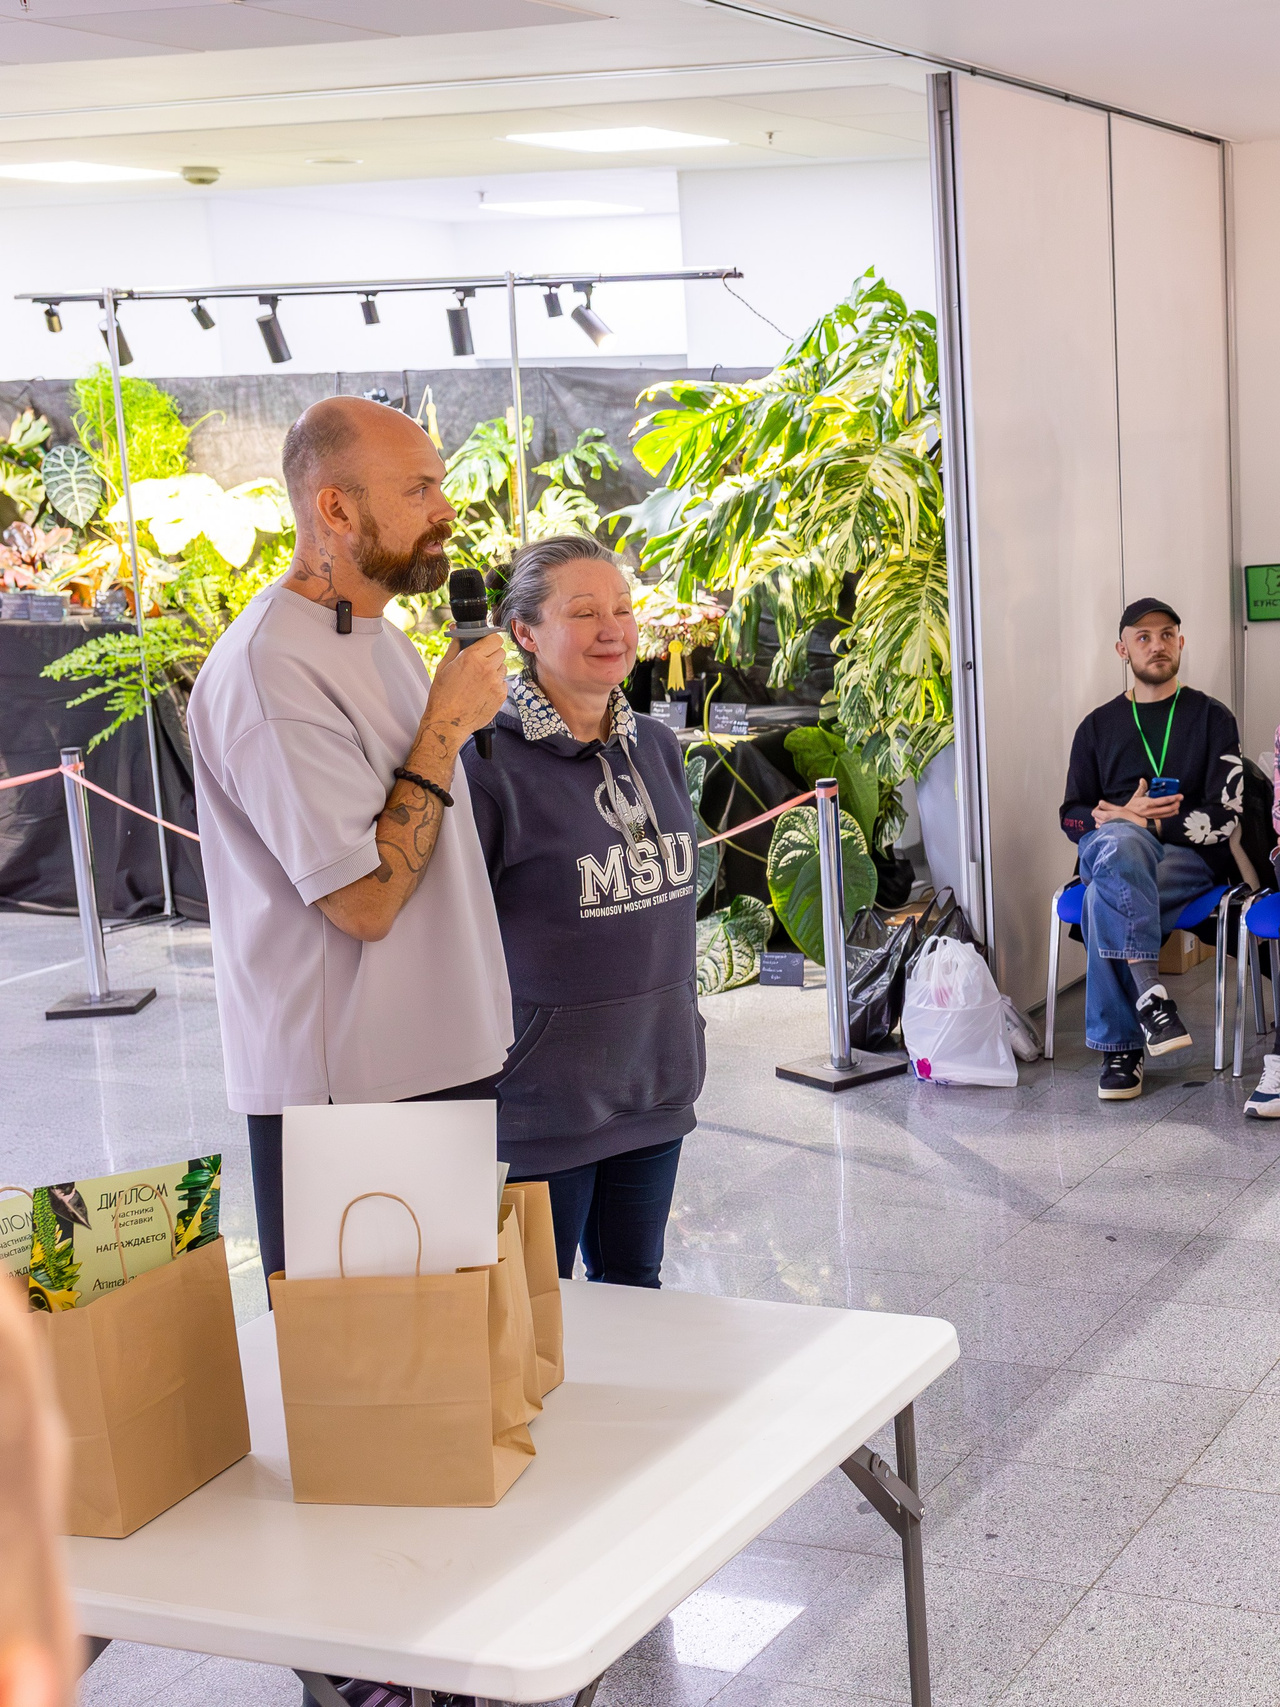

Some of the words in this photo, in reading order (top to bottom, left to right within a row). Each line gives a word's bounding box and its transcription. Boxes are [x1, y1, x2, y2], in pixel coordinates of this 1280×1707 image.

[576, 831, 694, 907] MSU
[580, 904, 623, 919] LOMONOSOV
[623, 897, 652, 912] MOSCOW
[652, 892, 669, 906] STATE
[668, 884, 694, 901] UNIVERSITY
[0, 1211, 33, 1235] ЛОМ
[111, 1206, 154, 1222] уастника
[118, 1215, 153, 1228] ыставки
[0, 1244, 32, 1260] выставк
